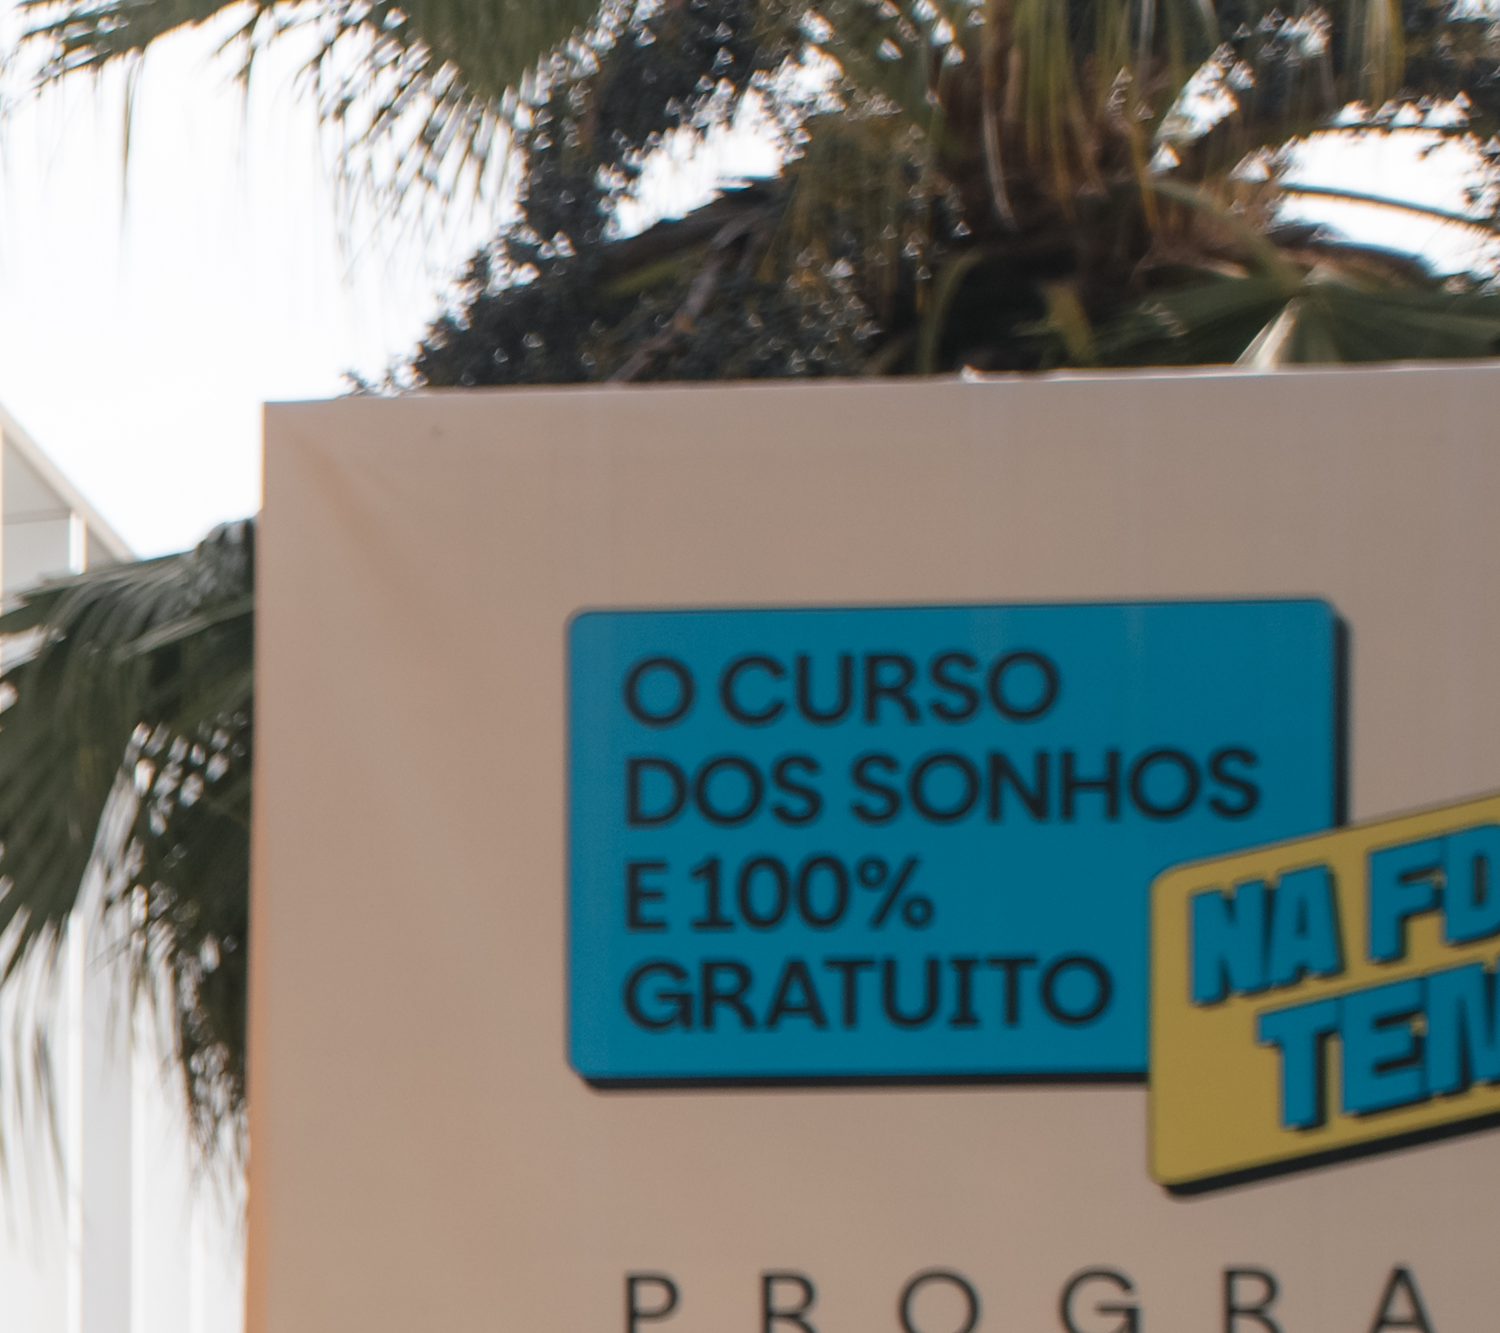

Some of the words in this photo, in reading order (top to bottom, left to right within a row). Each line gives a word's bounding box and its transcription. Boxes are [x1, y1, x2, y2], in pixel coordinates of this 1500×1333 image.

[621, 653, 696, 728] O
[719, 648, 1062, 727] CURSO
[625, 752, 823, 829] DOS
[850, 744, 1262, 825] SONHOS
[627, 858, 669, 934] E
[691, 854, 935, 933] 100%
[1189, 864, 1344, 1006] NA
[621, 953, 1115, 1034] GRATUITO
